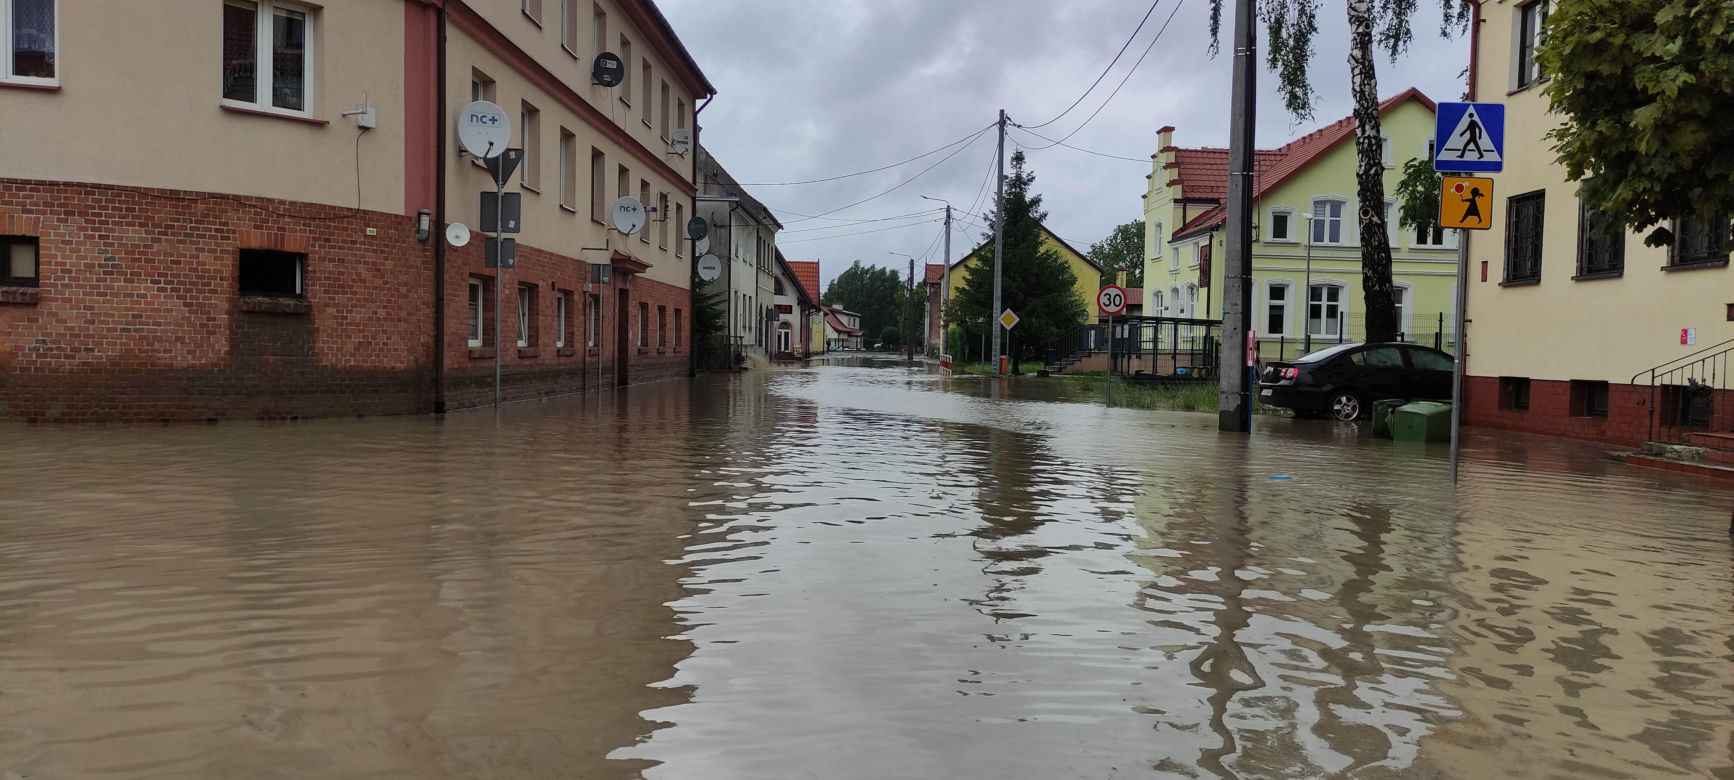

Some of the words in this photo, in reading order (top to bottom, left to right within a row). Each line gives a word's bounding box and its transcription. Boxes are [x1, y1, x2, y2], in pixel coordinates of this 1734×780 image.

[470, 113, 498, 125] nc+
[620, 205, 637, 213] nc+
[1103, 293, 1122, 307] 30
